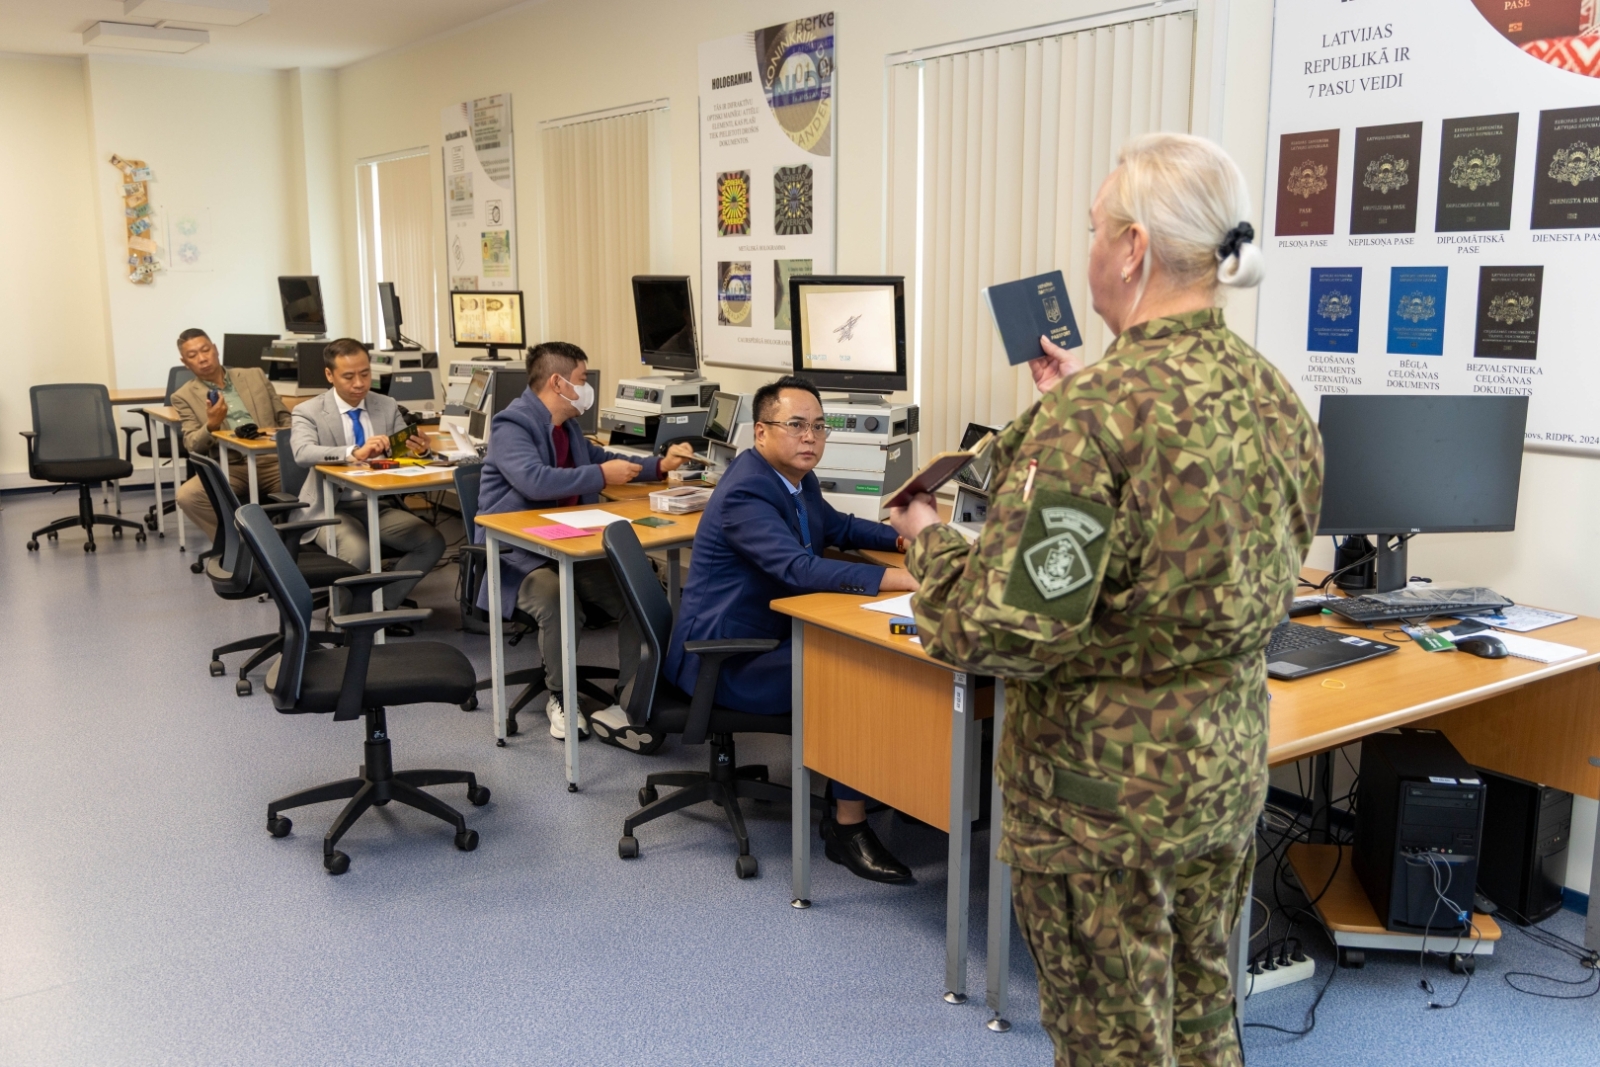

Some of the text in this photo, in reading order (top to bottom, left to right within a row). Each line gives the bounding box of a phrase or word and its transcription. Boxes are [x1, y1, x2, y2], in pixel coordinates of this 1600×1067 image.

[1504, 0, 1531, 10] PASE
[1321, 23, 1393, 48] LATVIJAS
[1303, 47, 1411, 75] REPUBLIKĀ IR
[711, 71, 753, 90] HOLOGRAMMA
[1307, 73, 1404, 99] 7 PASU VEIDI
[1348, 237, 1415, 248] NEPILSOŅA PASE
[1437, 233, 1505, 244] DIPLOMĀTISKĀ
[1532, 232, 1600, 243] DIENESTA PAS
[1278, 239, 1328, 249] PILSOŅA PASE
[1457, 246, 1480, 254] PASE
[1309, 355, 1355, 365] CEĻOŠANAS
[1399, 359, 1428, 370] BĒGĻA
[1308, 365, 1356, 375] DOKUMENTS
[1388, 369, 1439, 380] CEĻOŠANAS
[1466, 363, 1543, 375] BEZVALSTNIEKA
[1301, 374, 1362, 385] (ALTERNATĪVAIS
[1475, 373, 1532, 385] CEĻOŠANAS
[1313, 384, 1349, 394] STATUSS)
[1386, 380, 1440, 390] DOKUMENTS
[1473, 385, 1533, 396] DOKUMENTS
[1524, 432, 1599, 444] novs, RIDPK, 2024
